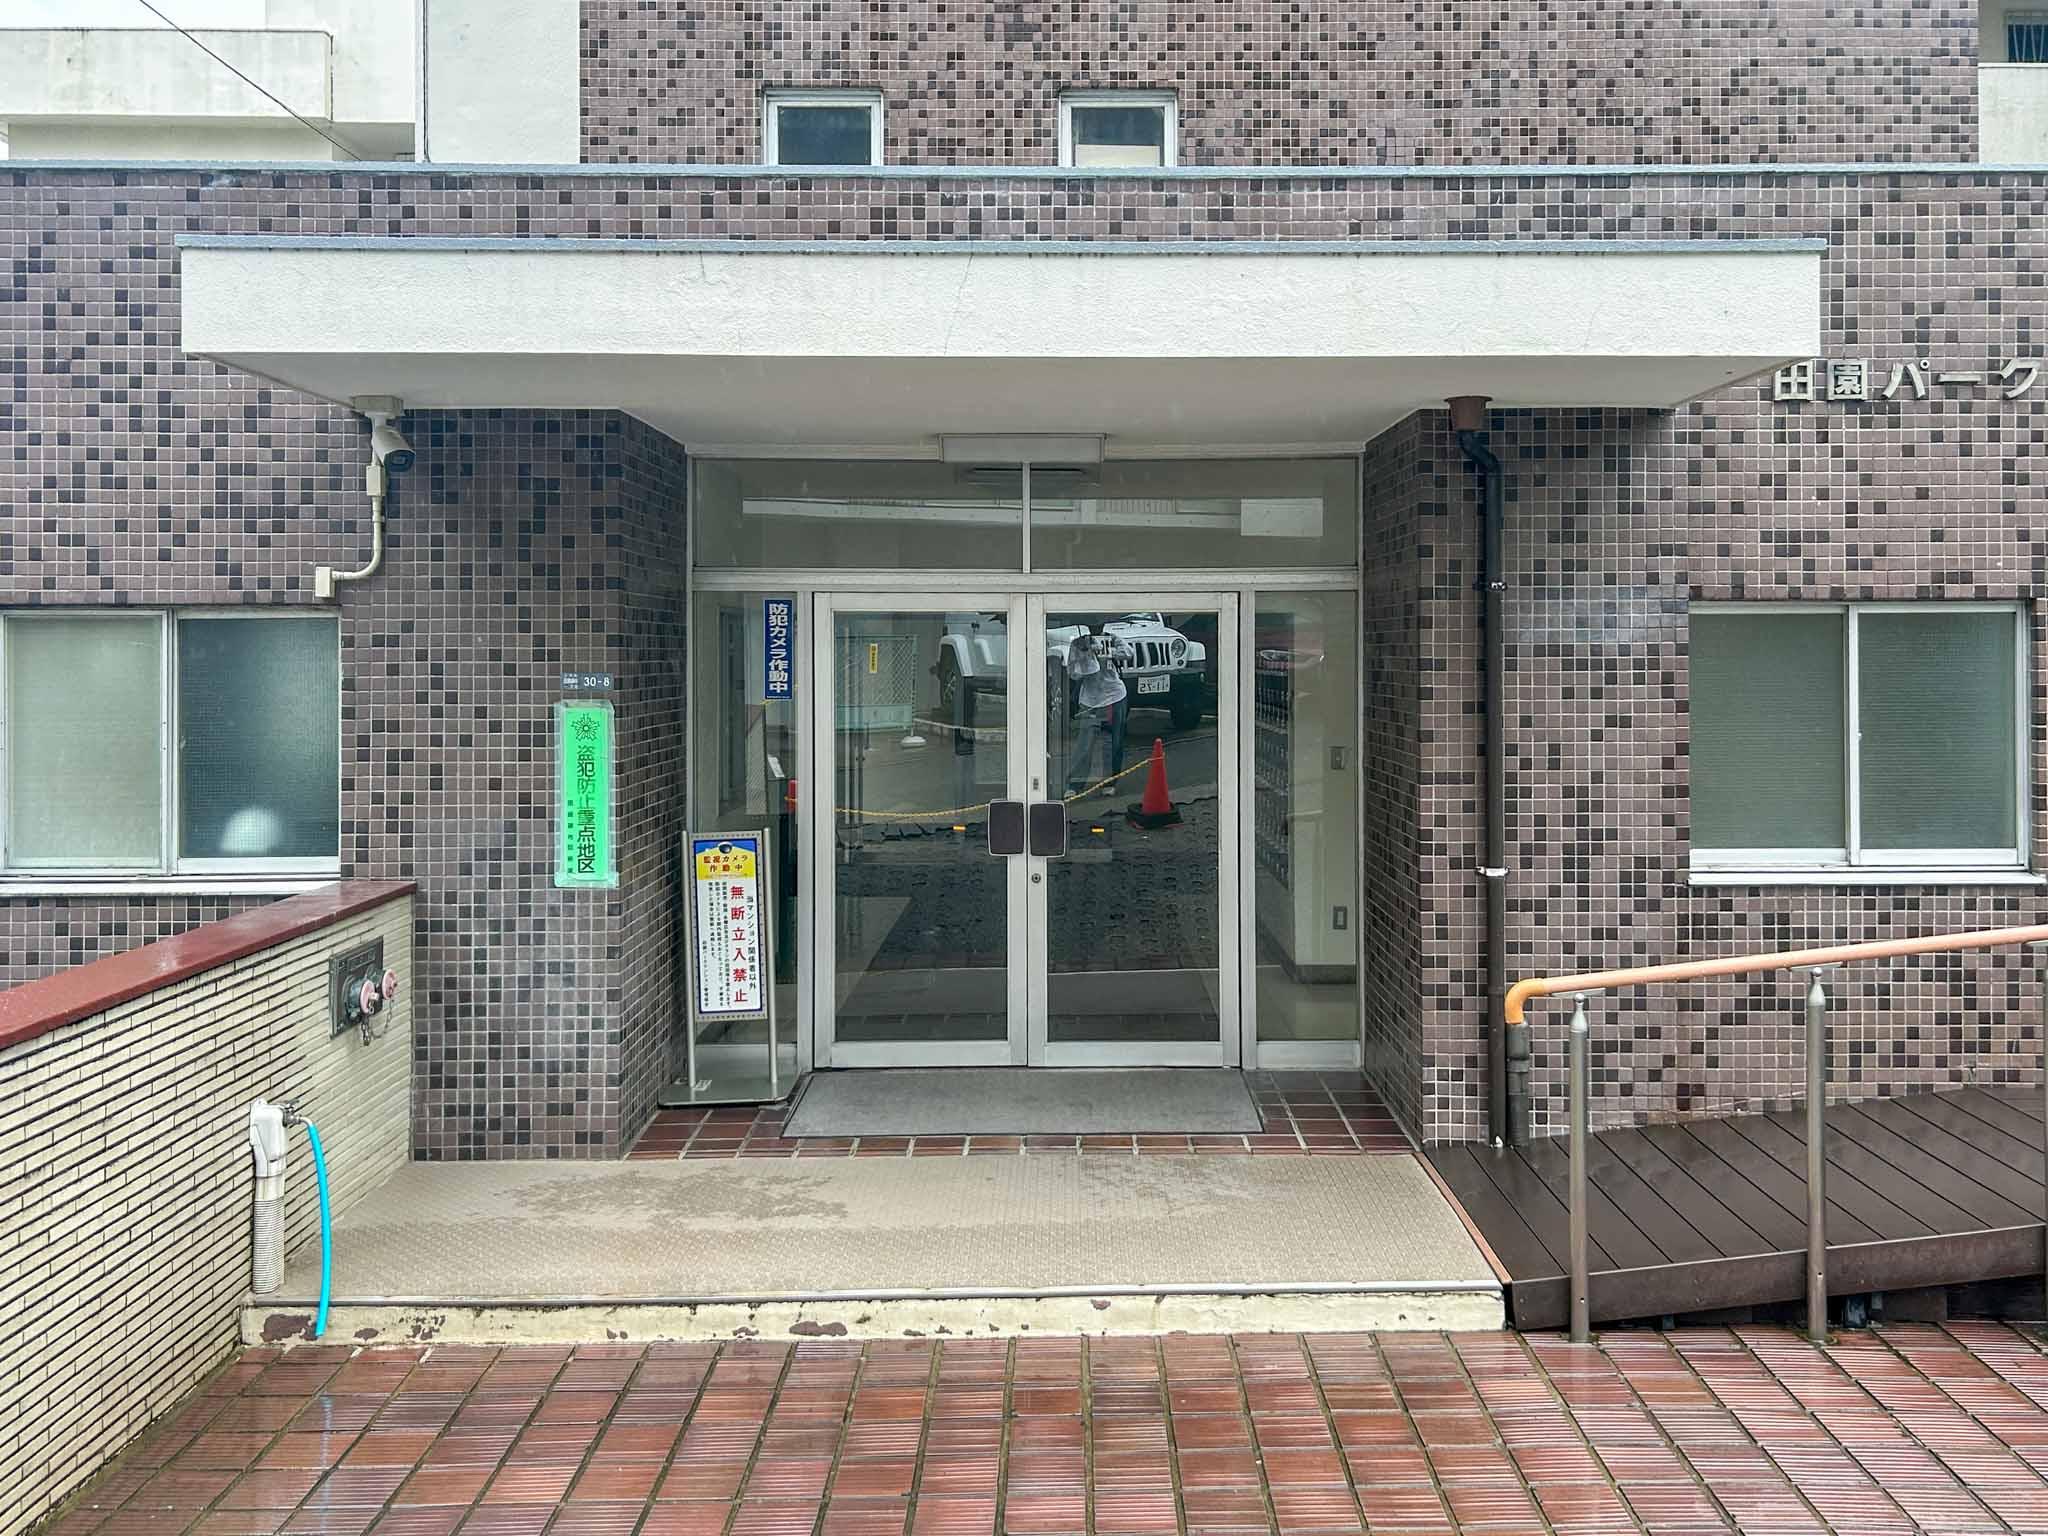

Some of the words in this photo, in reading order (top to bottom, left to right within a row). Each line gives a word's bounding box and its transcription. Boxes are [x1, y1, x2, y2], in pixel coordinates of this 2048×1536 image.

[1774, 358, 2040, 401] 田園パーク
[768, 603, 789, 693] 防犯カメラ作動中
[583, 676, 610, 687] 30-8
[576, 745, 596, 874] 盗犯防止重点地区
[703, 854, 748, 864] 監視カメラ
[710, 863, 743, 873] 作動中
[730, 886, 748, 1003] 無断立入禁止
